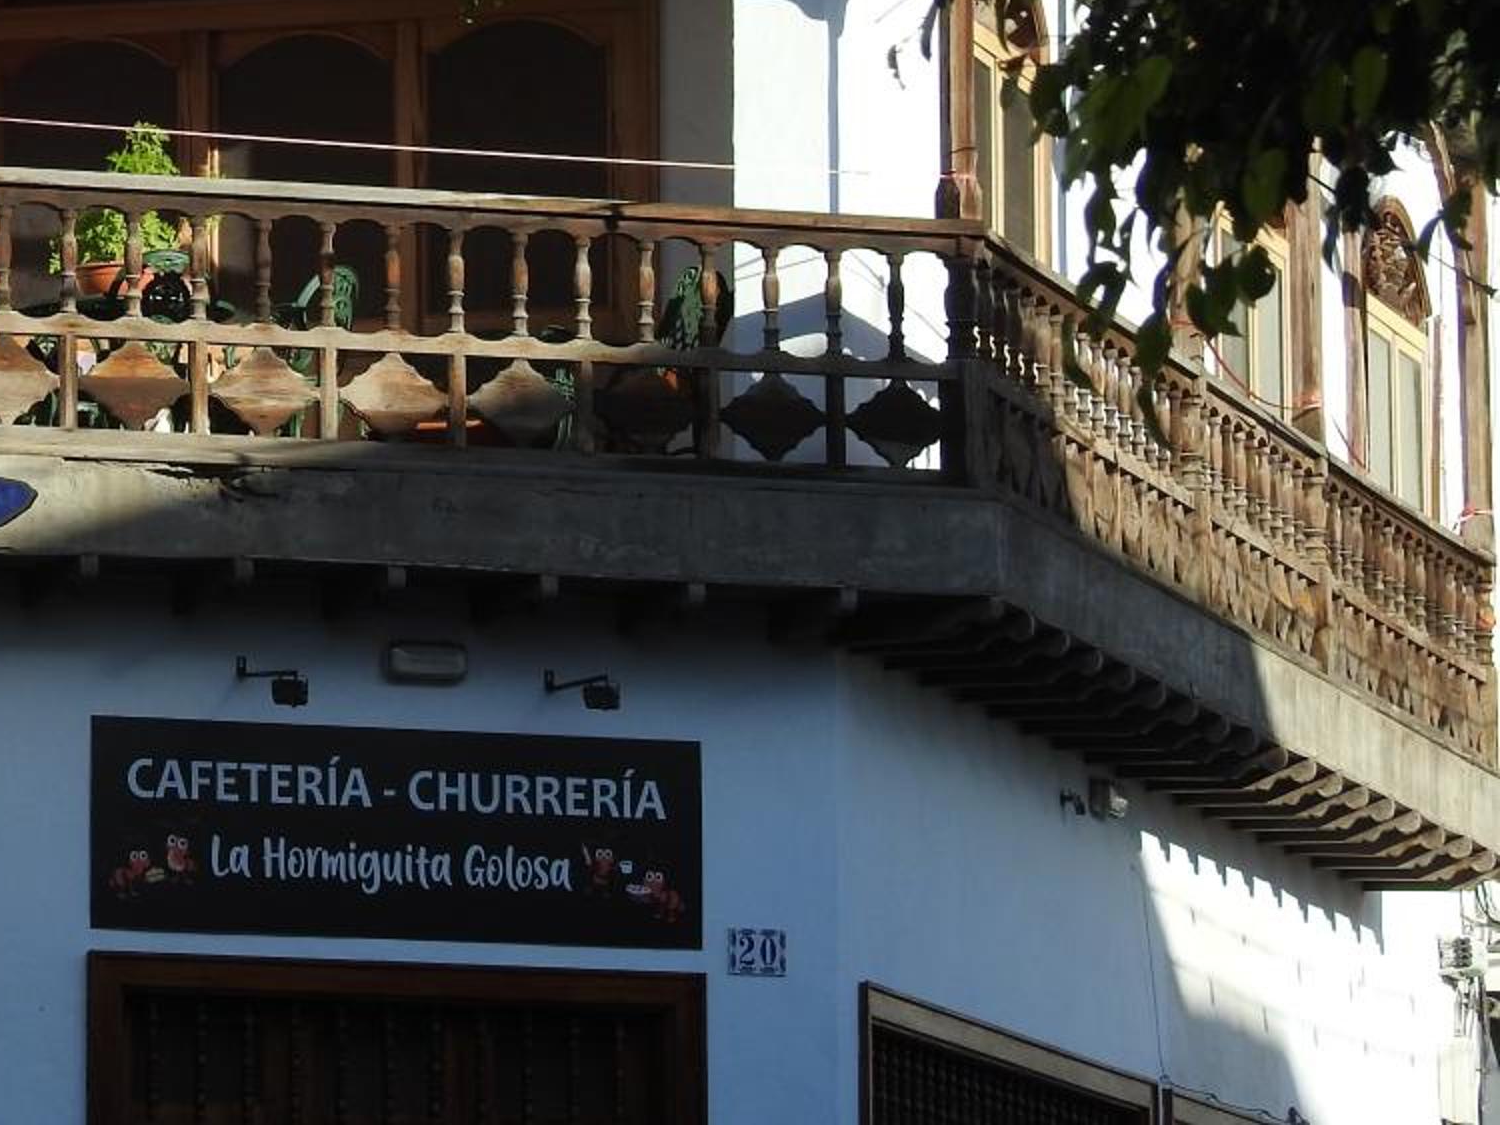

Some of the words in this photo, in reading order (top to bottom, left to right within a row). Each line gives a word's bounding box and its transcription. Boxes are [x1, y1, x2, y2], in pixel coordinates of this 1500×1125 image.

[127, 756, 373, 808] CAFETERÍA
[408, 769, 667, 820] CHURRERÍA
[211, 834, 252, 878] La
[263, 836, 452, 894] Hormiguita
[465, 843, 572, 892] Golosa
[739, 935, 778, 969] 20
